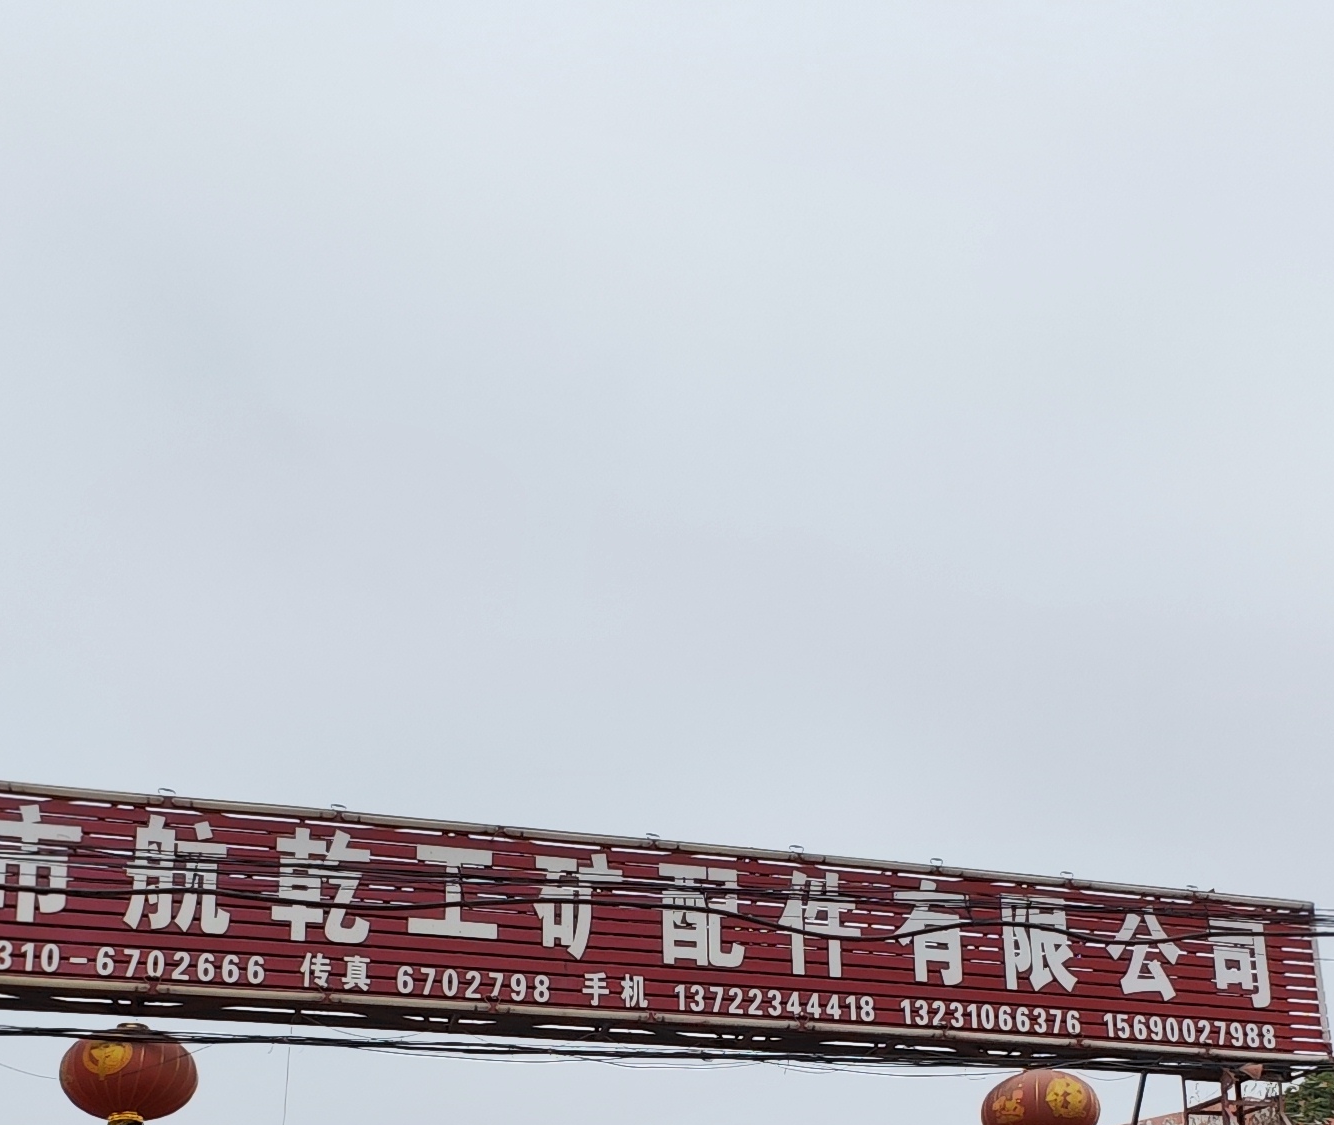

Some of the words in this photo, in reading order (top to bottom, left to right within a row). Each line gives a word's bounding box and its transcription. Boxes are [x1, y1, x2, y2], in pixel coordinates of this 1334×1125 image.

[300, 952, 371, 991] 传真
[396, 965, 550, 1002] 6702798
[582, 972, 649, 1008] 手机
[674, 984, 875, 1022] 13722344418
[900, 999, 1081, 1034] 13231066376
[1103, 1012, 1276, 1048] 15690027988
